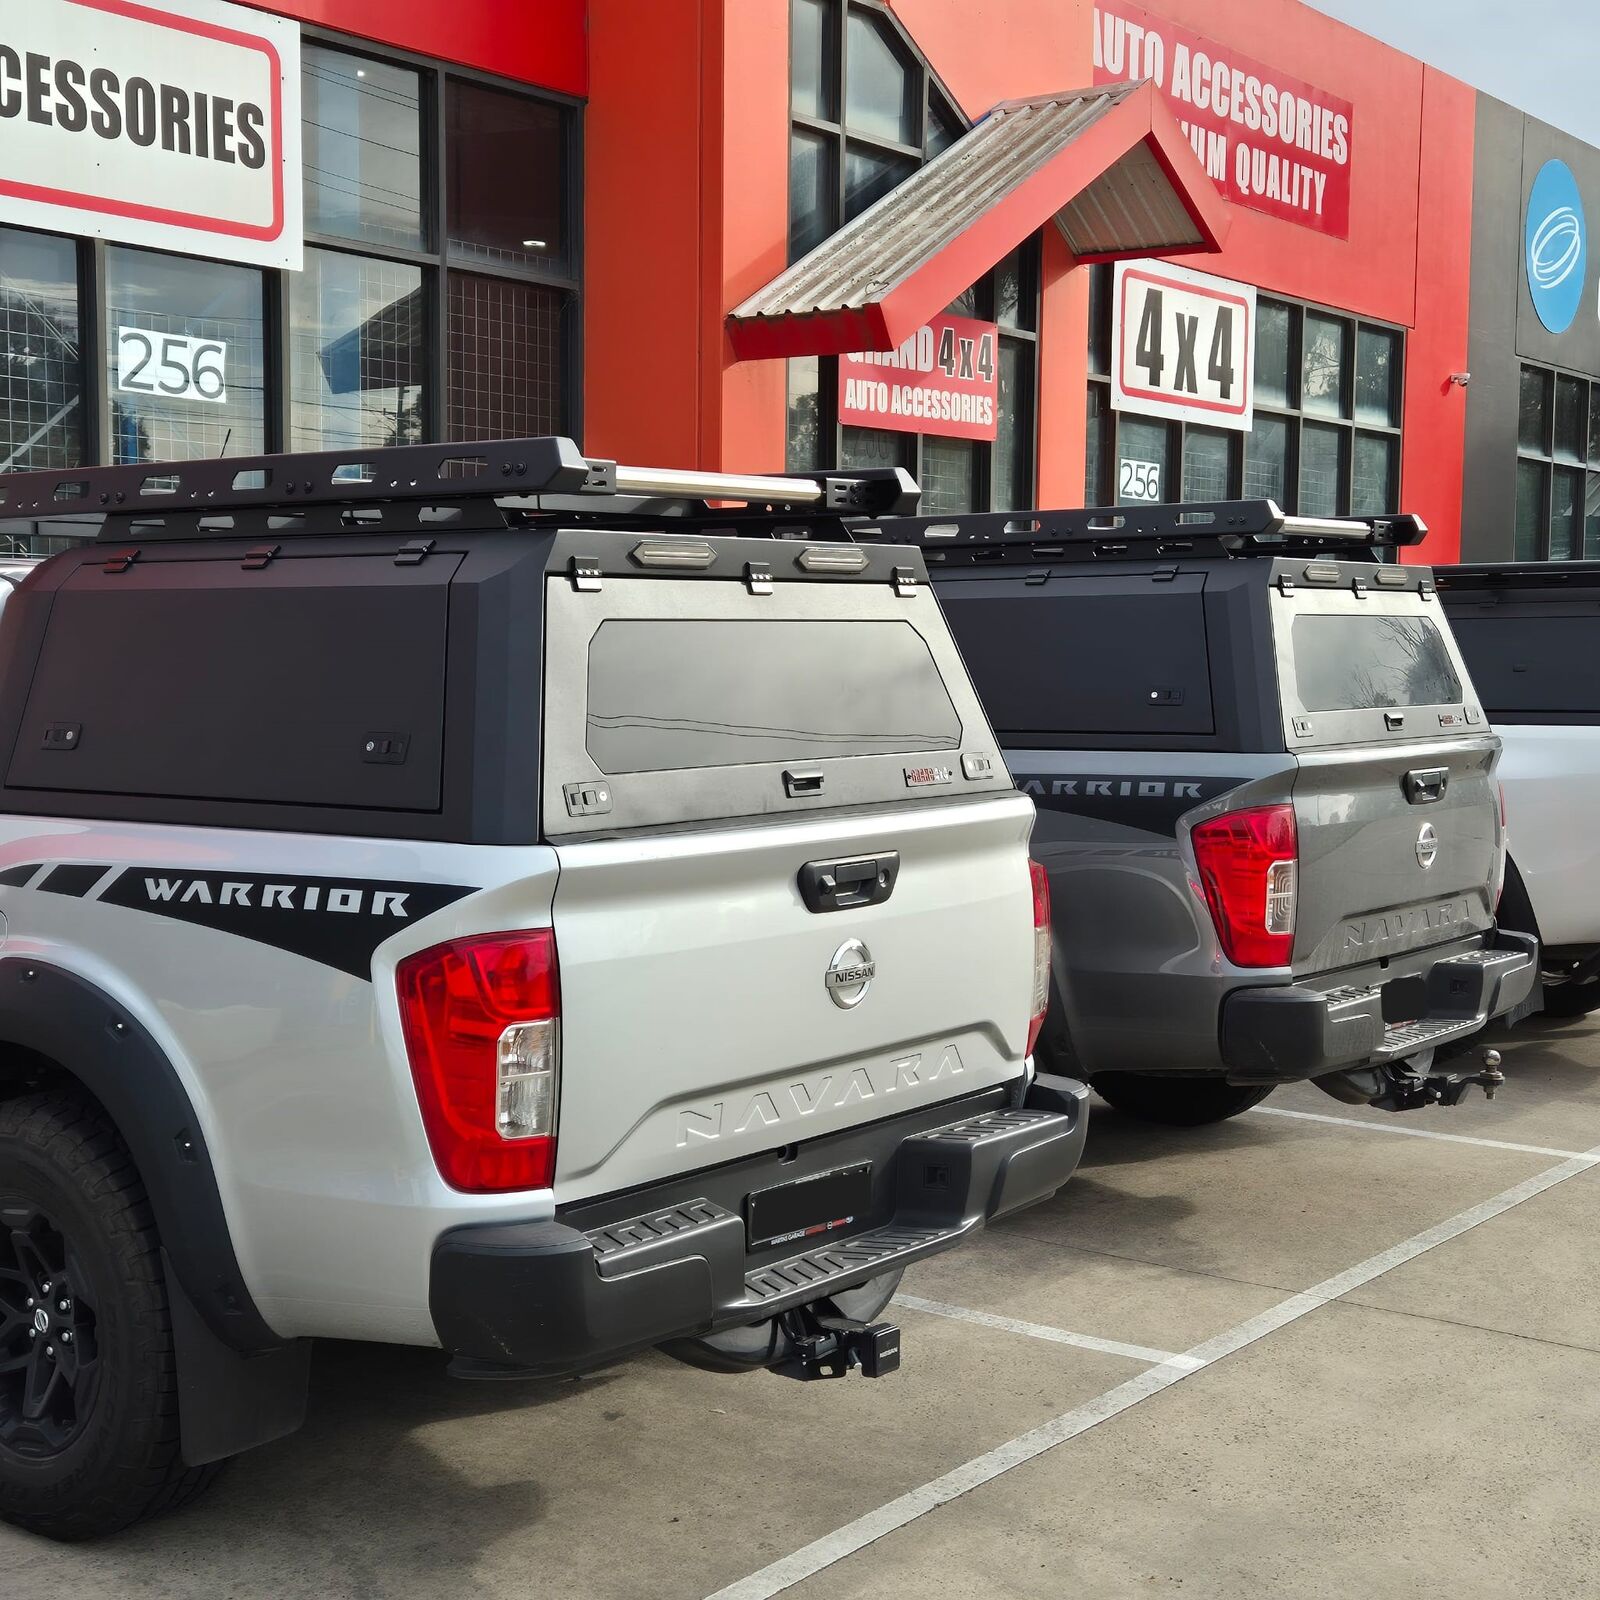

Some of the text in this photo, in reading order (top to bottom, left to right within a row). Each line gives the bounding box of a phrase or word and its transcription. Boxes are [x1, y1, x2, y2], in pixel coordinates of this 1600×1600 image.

[0, 44, 266, 170] CESSORIES
[1171, 42, 1348, 165] ACCESSORIES
[1235, 142, 1327, 216] QUALITY
[120, 332, 225, 399] 256
[844, 378, 993, 425] AUTO ACCESSORIES
[1120, 462, 1159, 499] 256
[1016, 779, 1202, 798] ARRIOR
[143, 876, 411, 917] WARRIOR
[835, 966, 874, 983] NISSAN
[675, 1043, 964, 1148] NAVARA
